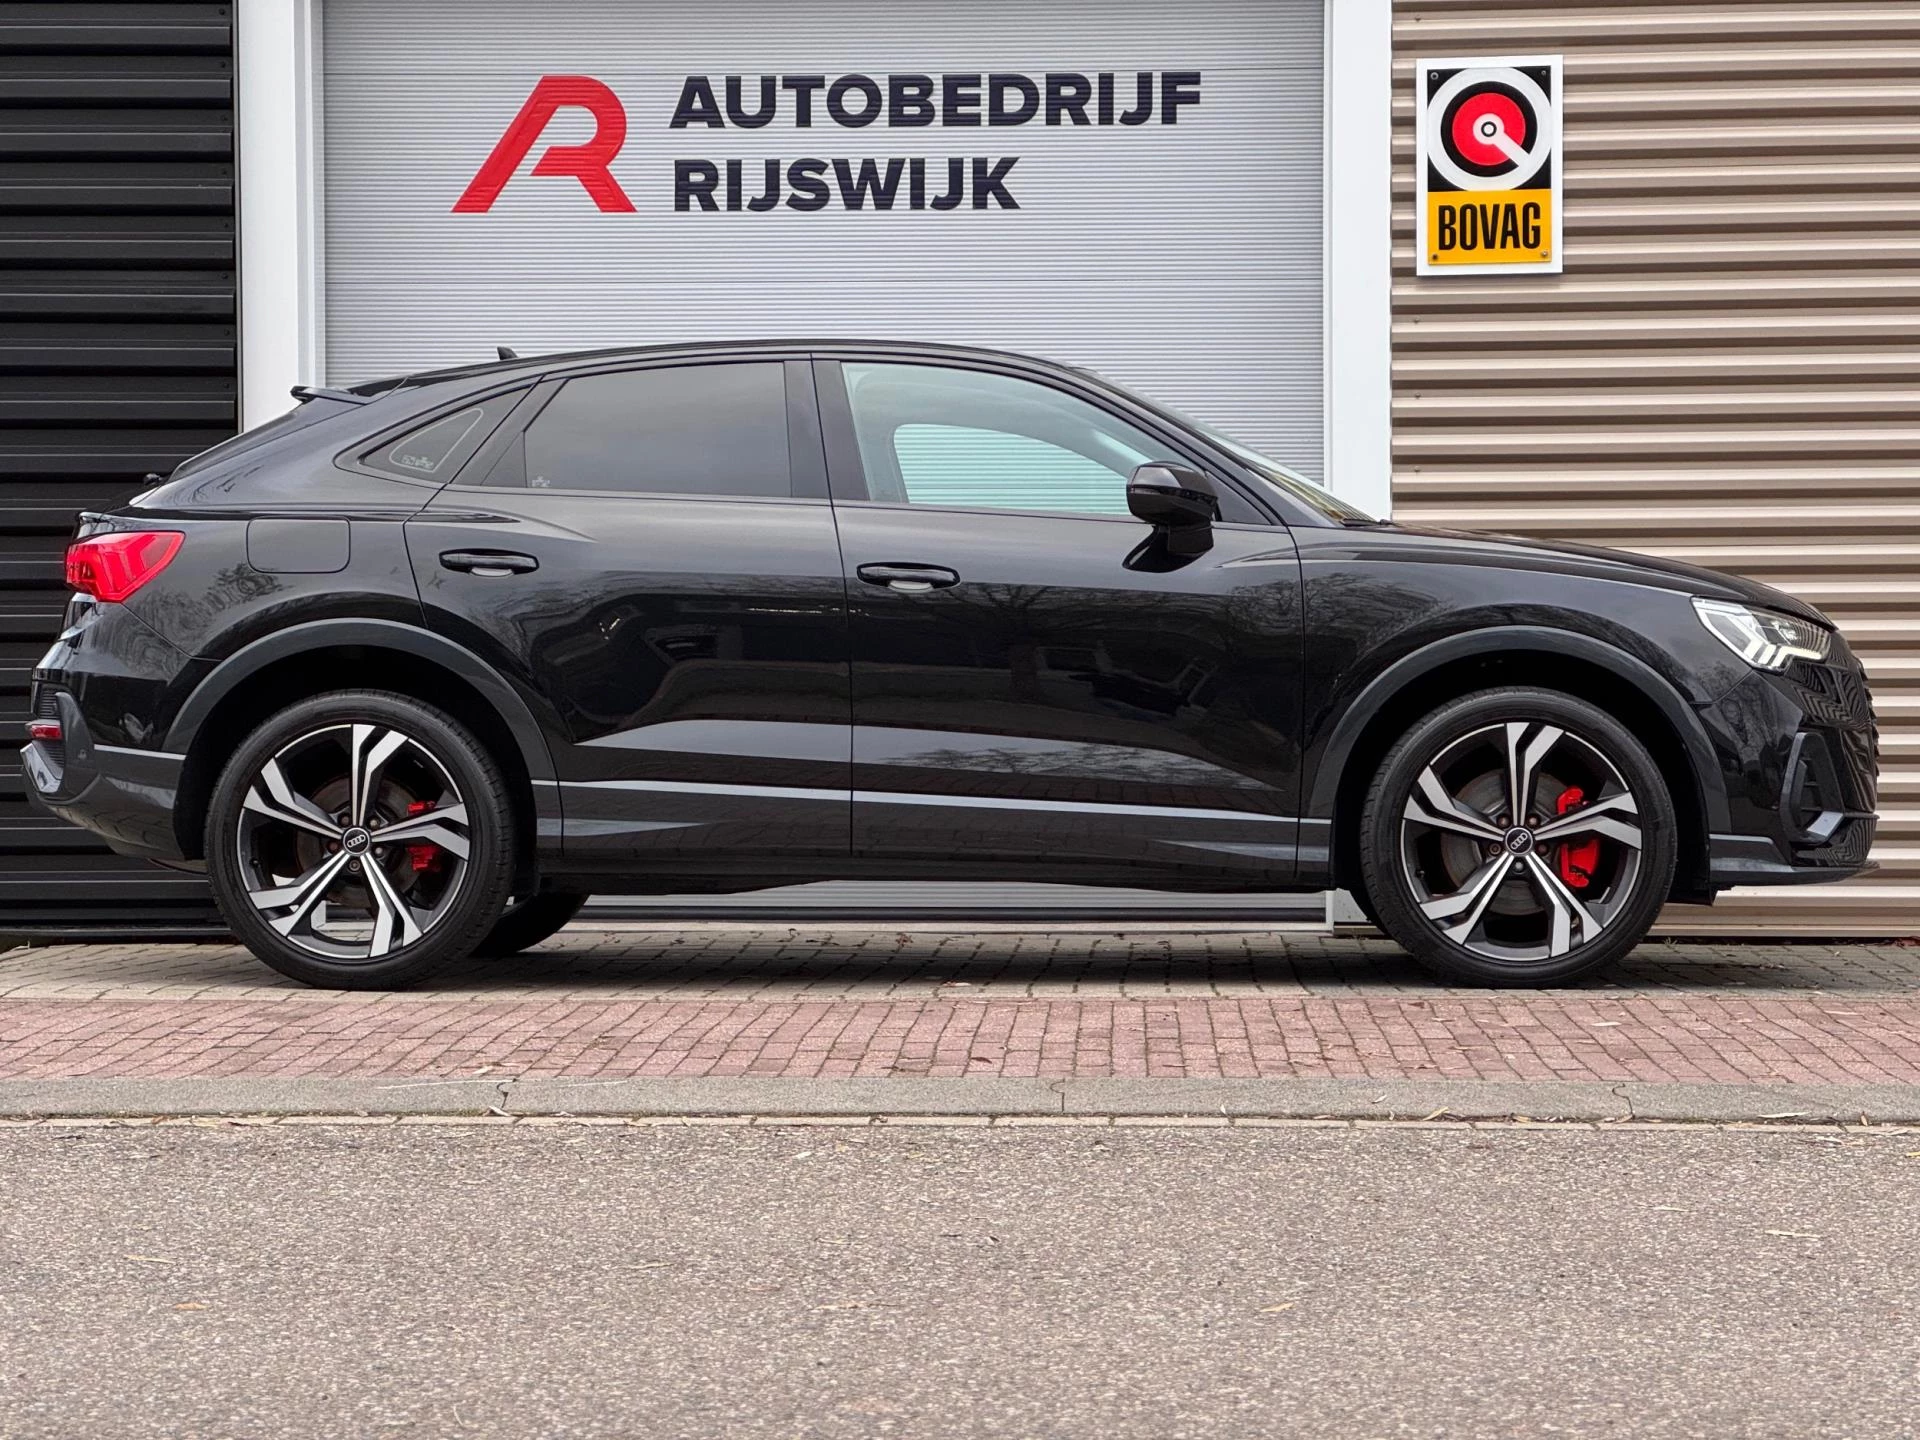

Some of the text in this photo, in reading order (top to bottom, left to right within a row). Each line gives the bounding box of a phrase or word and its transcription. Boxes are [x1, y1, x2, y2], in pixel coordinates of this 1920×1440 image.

[669, 71, 1201, 129] AUTOBEDRIJF
[674, 156, 1021, 212] RIJSWIJK
[1438, 202, 1541, 251] BOVAG
